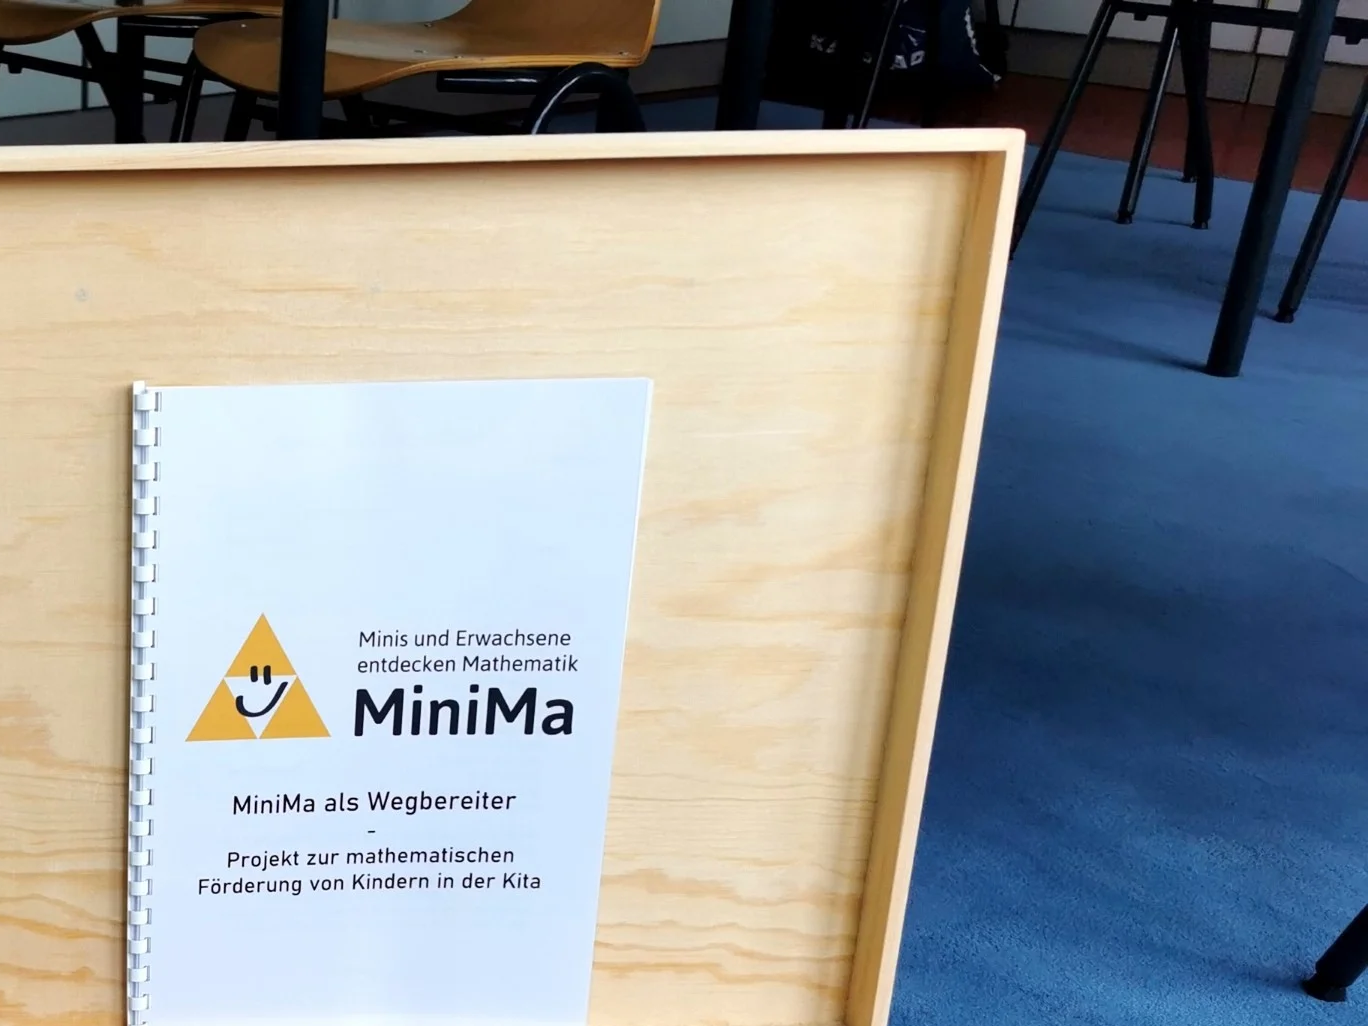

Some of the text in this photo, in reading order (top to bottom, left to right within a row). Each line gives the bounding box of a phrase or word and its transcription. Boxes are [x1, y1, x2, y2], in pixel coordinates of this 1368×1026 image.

[359, 628, 572, 648] Minis und Erwachsene
[357, 654, 578, 674] entdecken Mathematik
[354, 683, 574, 737] MiniMa
[233, 790, 517, 816] MiniMa als Wegbereiter
[227, 846, 514, 872] Projekt zur mathematischen
[198, 872, 541, 896] Förderung von Kindern in der Kita
